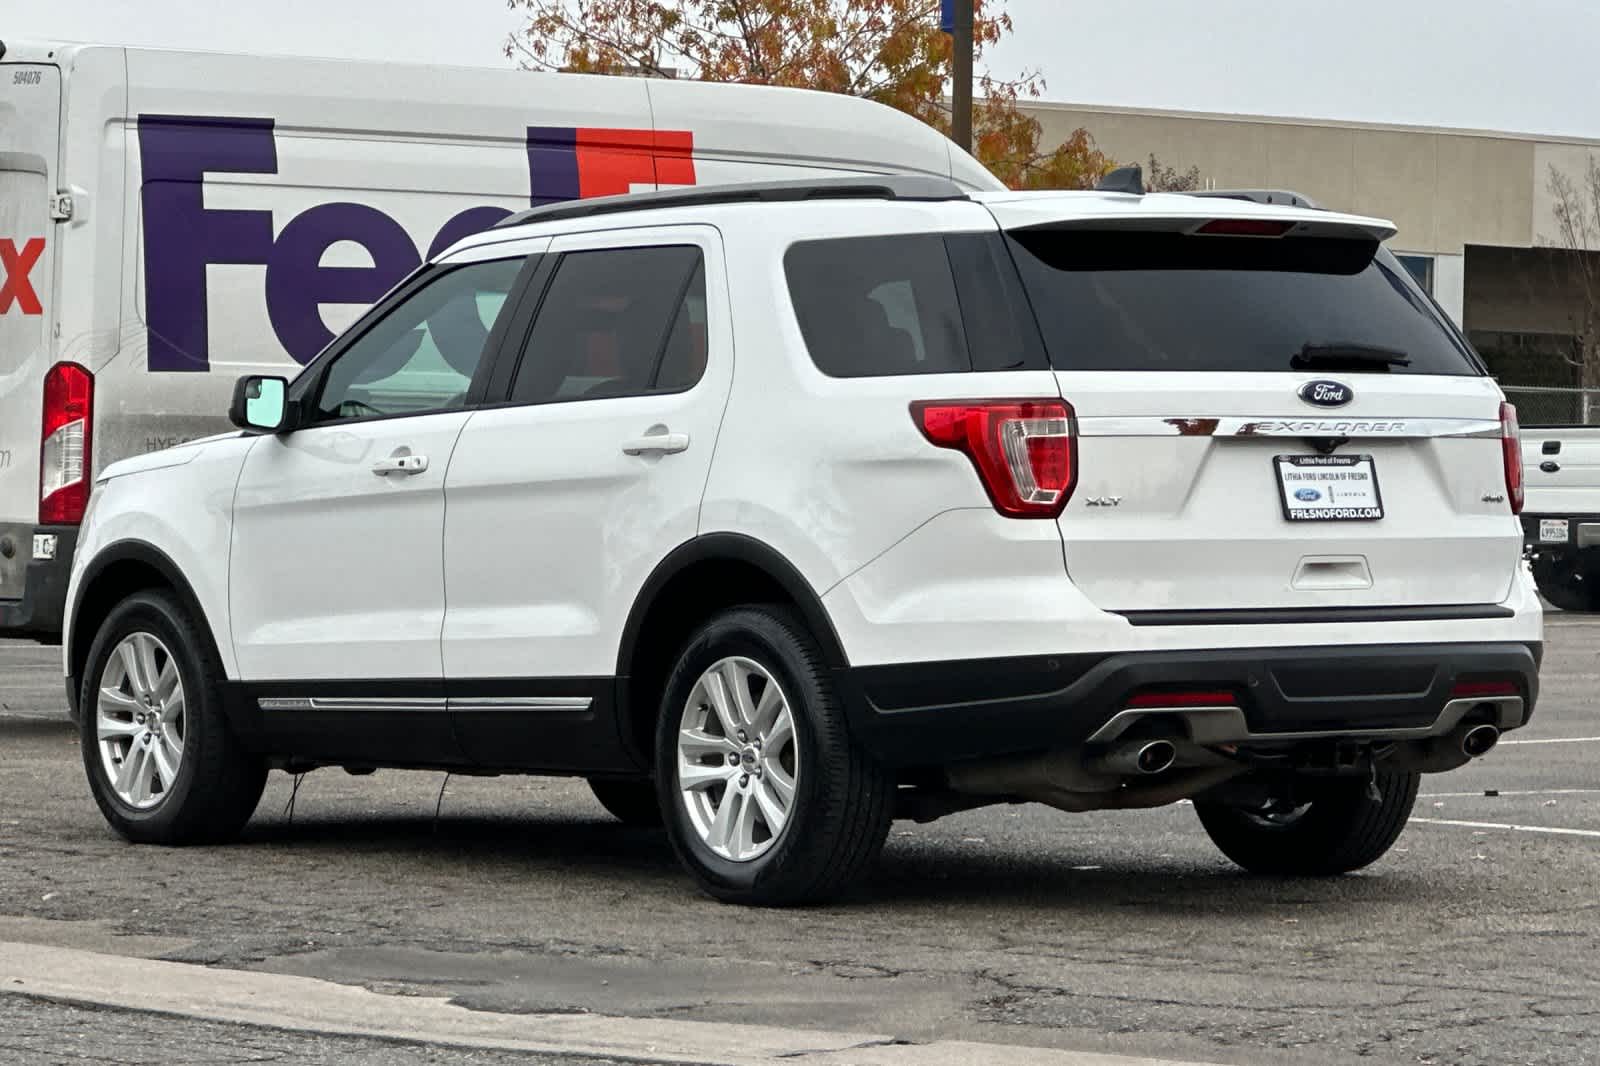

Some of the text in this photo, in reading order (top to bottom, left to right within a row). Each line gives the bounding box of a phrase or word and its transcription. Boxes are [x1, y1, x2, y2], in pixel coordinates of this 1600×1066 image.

[13, 71, 42, 85] 504076
[1313, 383, 1344, 401] Ford
[1254, 421, 1406, 433] EXPLORER
[1300, 457, 1315, 465] Lithia
[1316, 457, 1327, 465] Ford
[1333, 457, 1351, 465] Fresno
[1284, 472, 1368, 481] LITHIA FORD LINCOLN OF FRESNO
[1085, 496, 1122, 508] XLT
[1291, 508, 1381, 519] FRESNOFORD.COM
